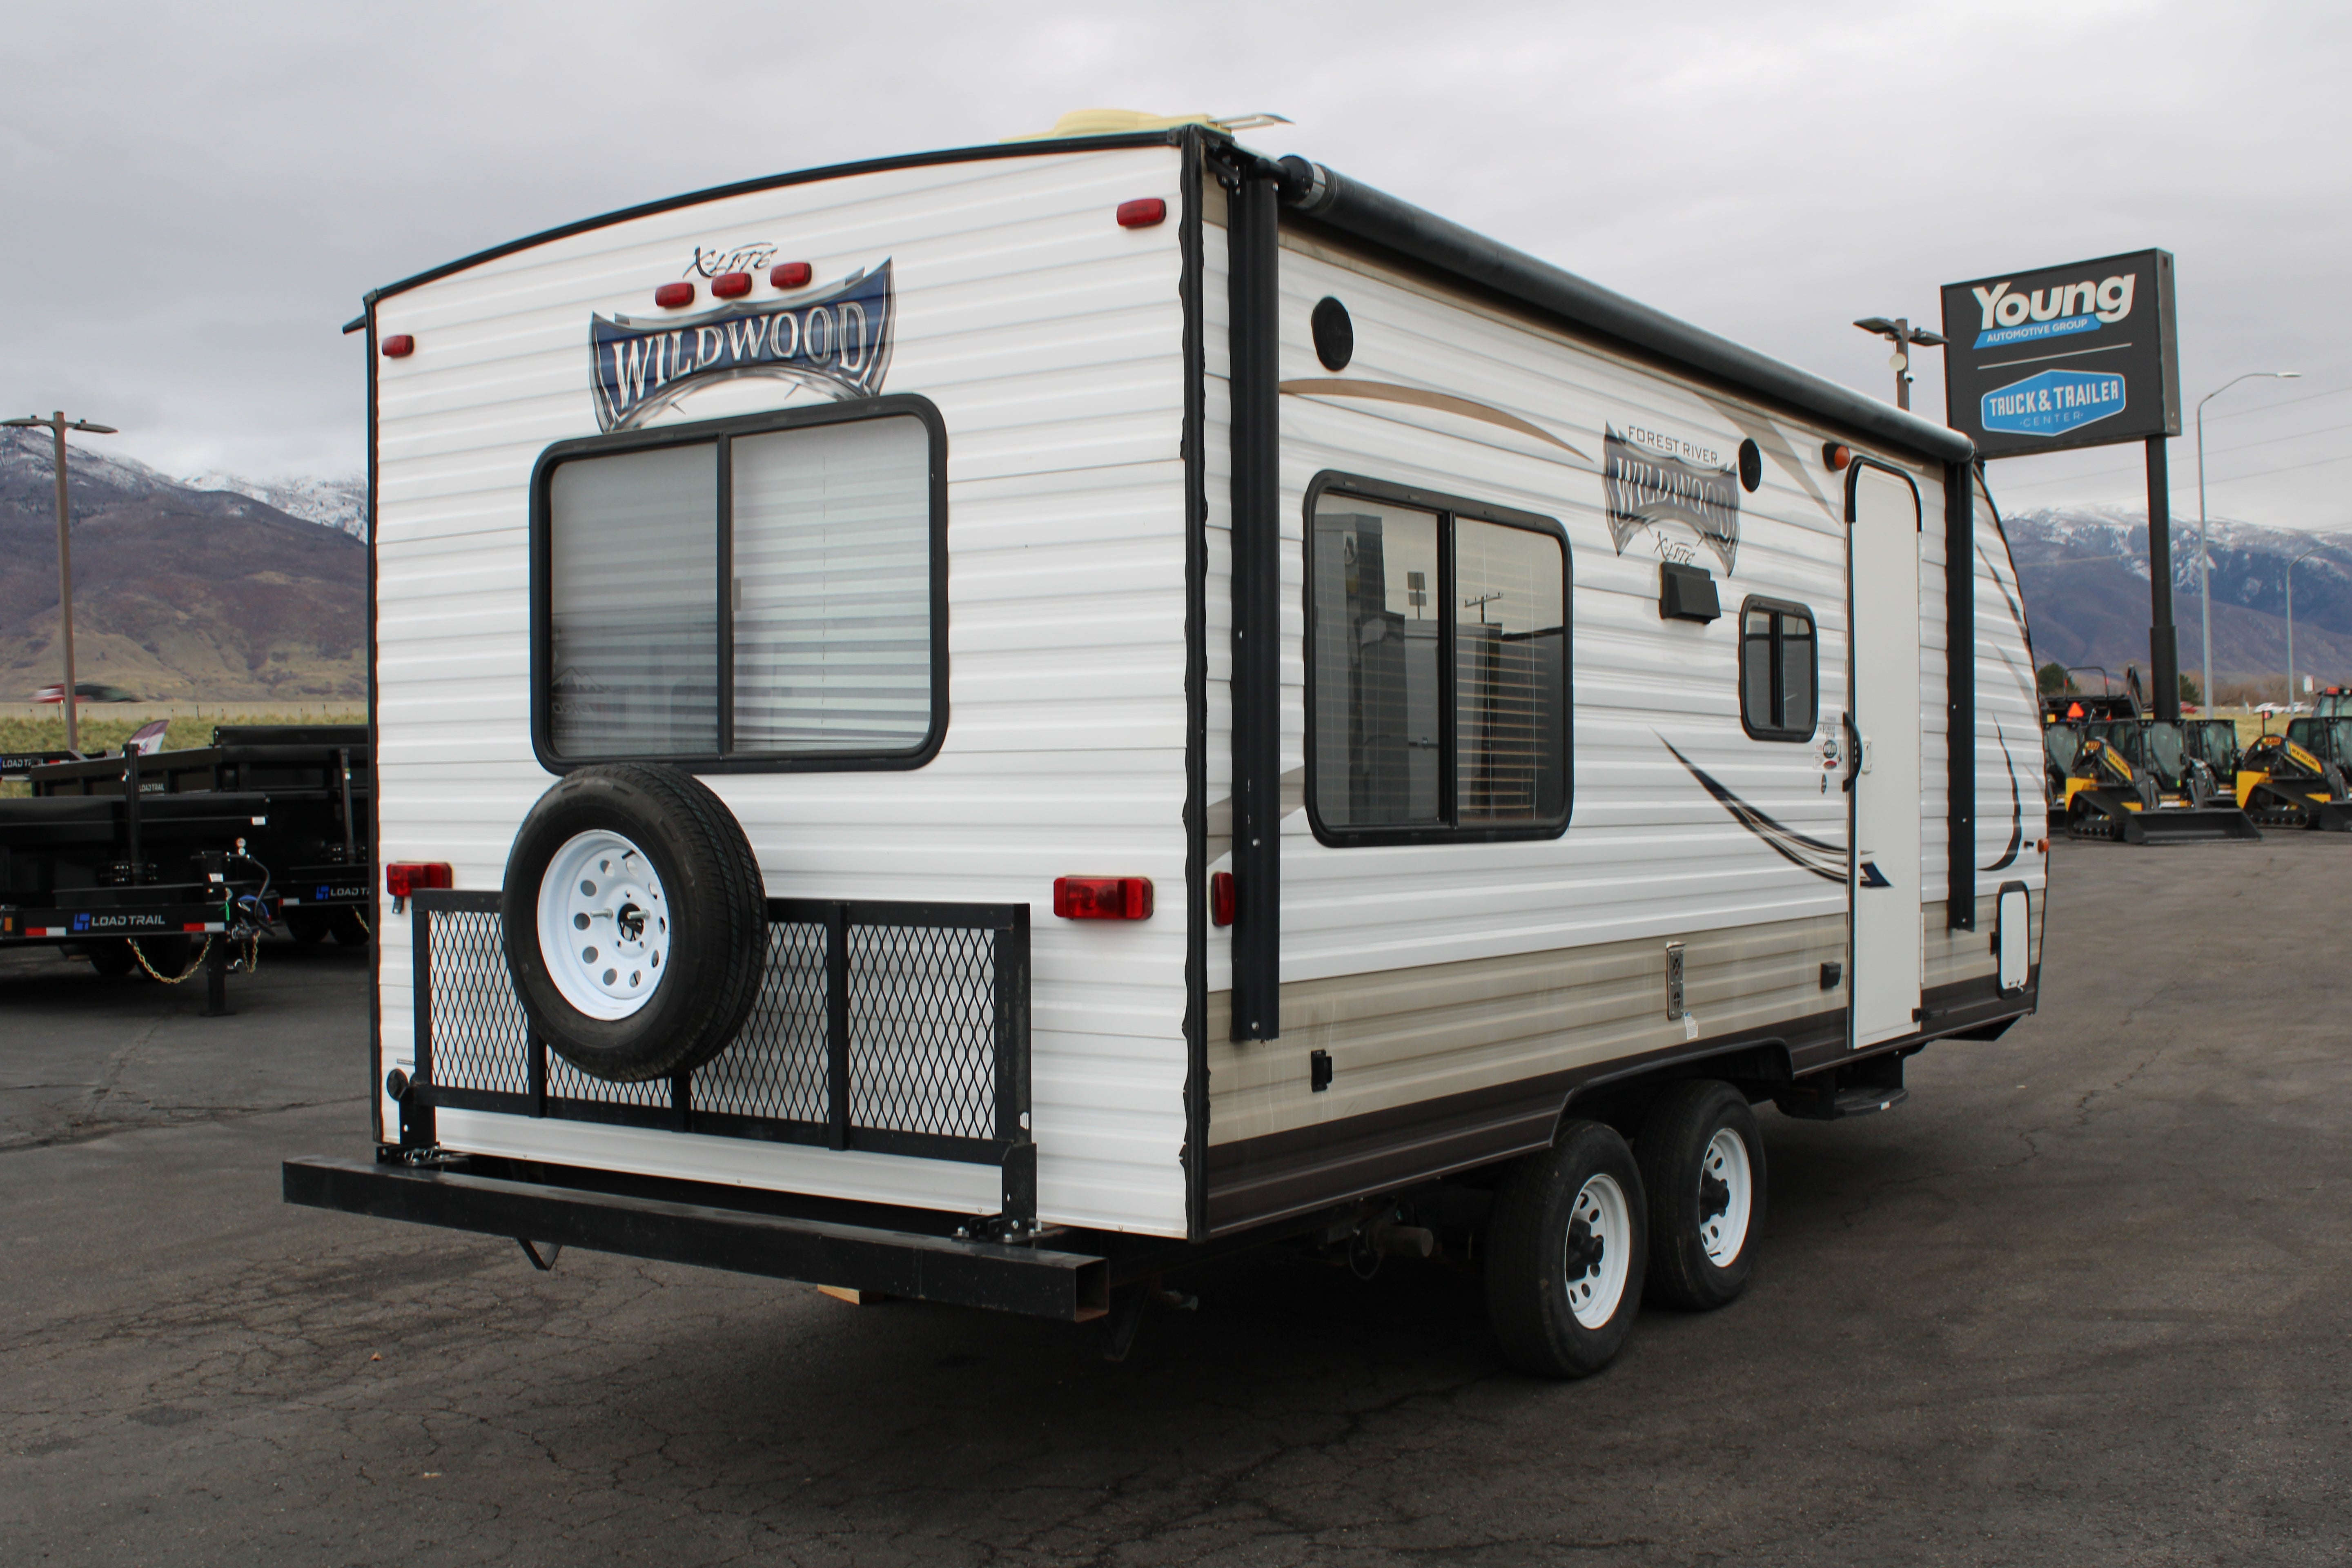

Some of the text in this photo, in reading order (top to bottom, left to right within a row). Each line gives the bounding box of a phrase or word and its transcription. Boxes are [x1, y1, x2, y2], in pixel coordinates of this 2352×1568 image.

[1972, 273, 2136, 331] Young
[1987, 318, 2088, 343] AUTOMOTIVE GROUP
[611, 301, 869, 411] WILDWOOD
[1989, 380, 2119, 417] TRUCK & TRAILER
[2022, 411, 2081, 428] CENTER
[1628, 425, 1718, 466] FOREST RIVER
[1616, 456, 1731, 540] WILDWOOD
[2, 758, 23, 768] LOAD
[330, 887, 359, 897] LOAD
[91, 915, 166, 927] LOAD TRAIL
